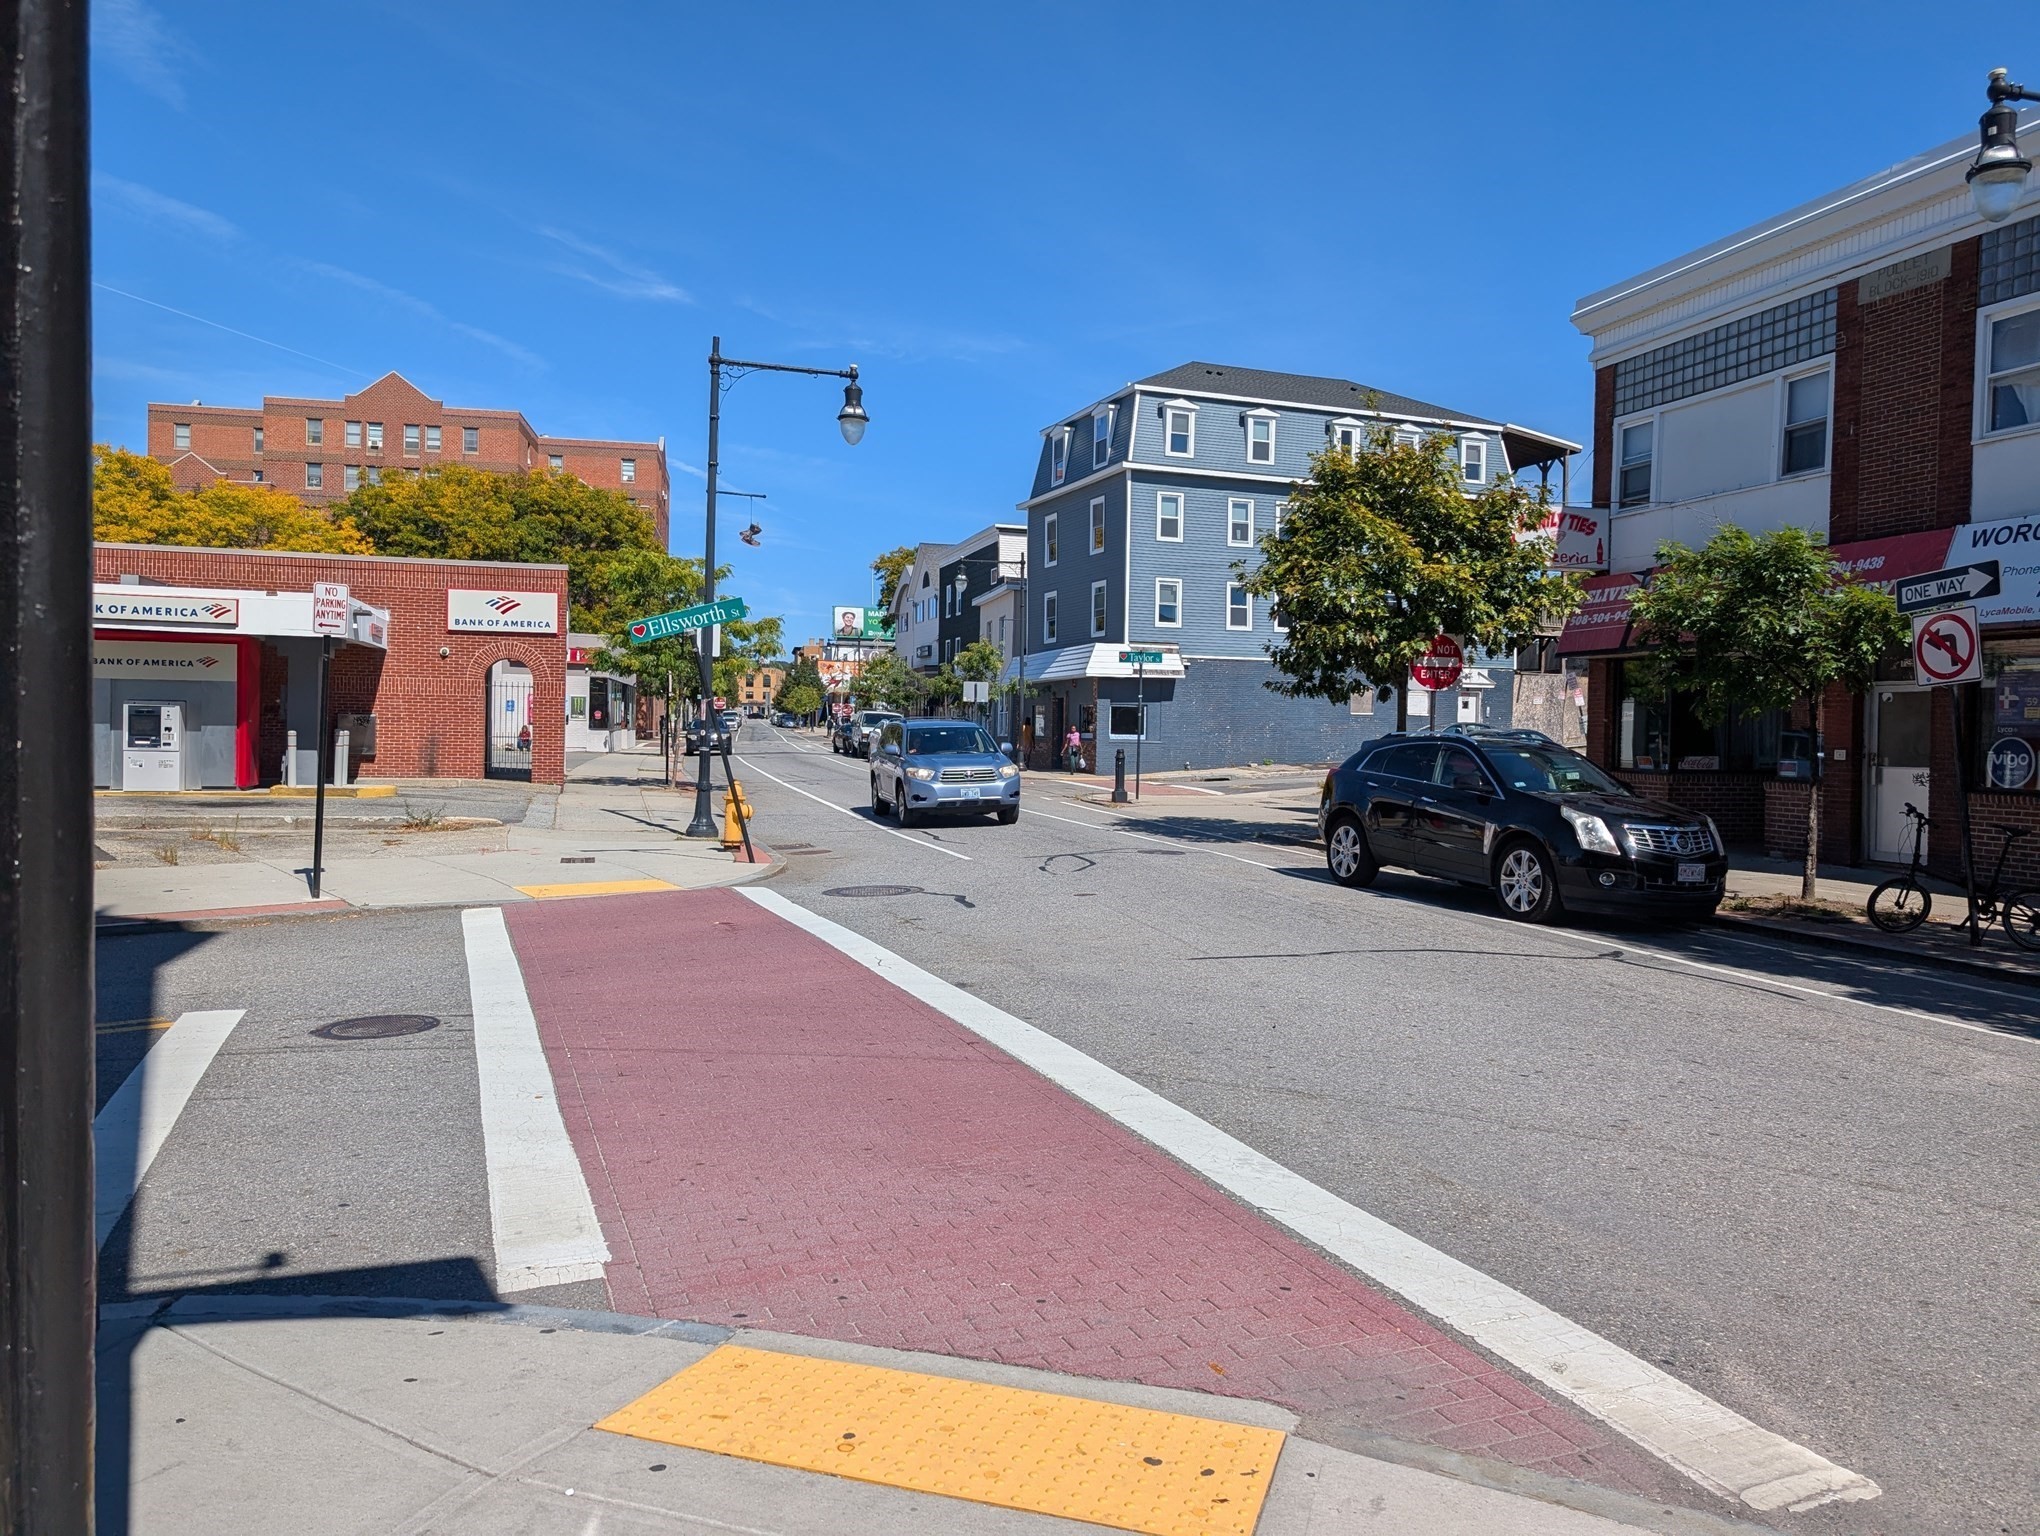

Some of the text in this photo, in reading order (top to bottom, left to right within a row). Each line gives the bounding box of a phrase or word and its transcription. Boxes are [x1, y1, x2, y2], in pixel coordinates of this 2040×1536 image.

[1567, 513, 1598, 537] TIES
[1831, 555, 1885, 574] 304-9438
[325, 586, 338, 597] NO
[1583, 583, 1641, 605] ELIVER
[1905, 584, 1931, 602] ONE
[1936, 577, 1966, 596] WAY
[316, 598, 346, 610] PARKING
[108, 604, 127, 615] OF
[131, 606, 199, 618] AMERICA
[315, 609, 346, 622] ANYTIME
[454, 618, 552, 629] BANK OF AMERICA
[646, 604, 741, 638] Ellsworth St
[1570, 608, 1633, 627] 508-304-94
[1437, 645, 1456, 655] NOT
[126, 657, 140, 667] OF
[143, 658, 194, 668] AMERICA
[1129, 652, 1154, 664] Taylor
[1420, 669, 1451, 679] ENTER
[1997, 725, 2014, 737] Lyca
